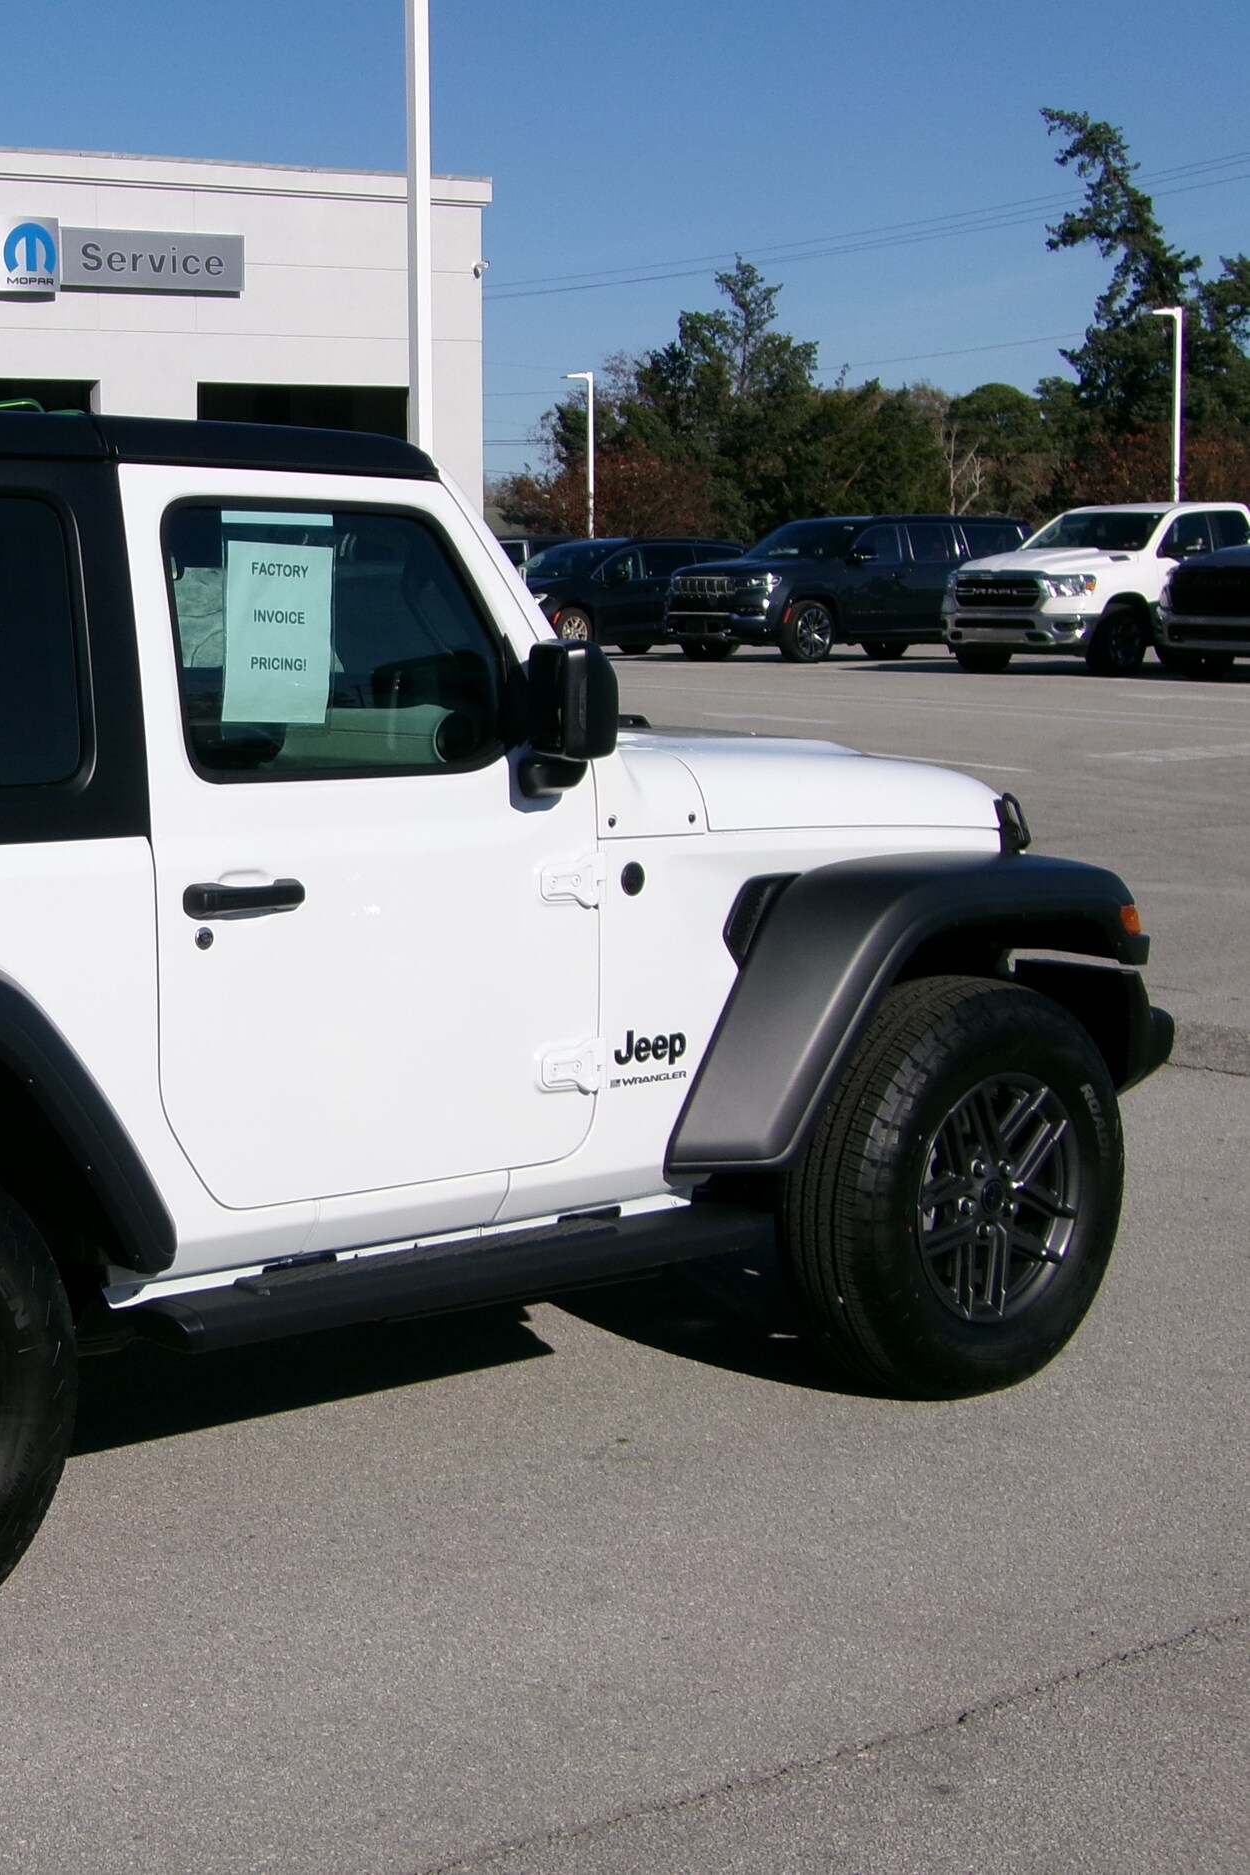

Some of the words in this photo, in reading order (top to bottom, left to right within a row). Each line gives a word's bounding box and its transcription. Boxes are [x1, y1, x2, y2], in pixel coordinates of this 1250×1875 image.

[81, 242, 224, 276] Service
[6, 276, 55, 286] MOPAR
[251, 562, 309, 579] FACTORY
[253, 608, 306, 625] INVOICE
[251, 656, 307, 672] PRICING!
[614, 1029, 687, 1066] Jeep
[621, 1070, 687, 1086] WRANGLER
